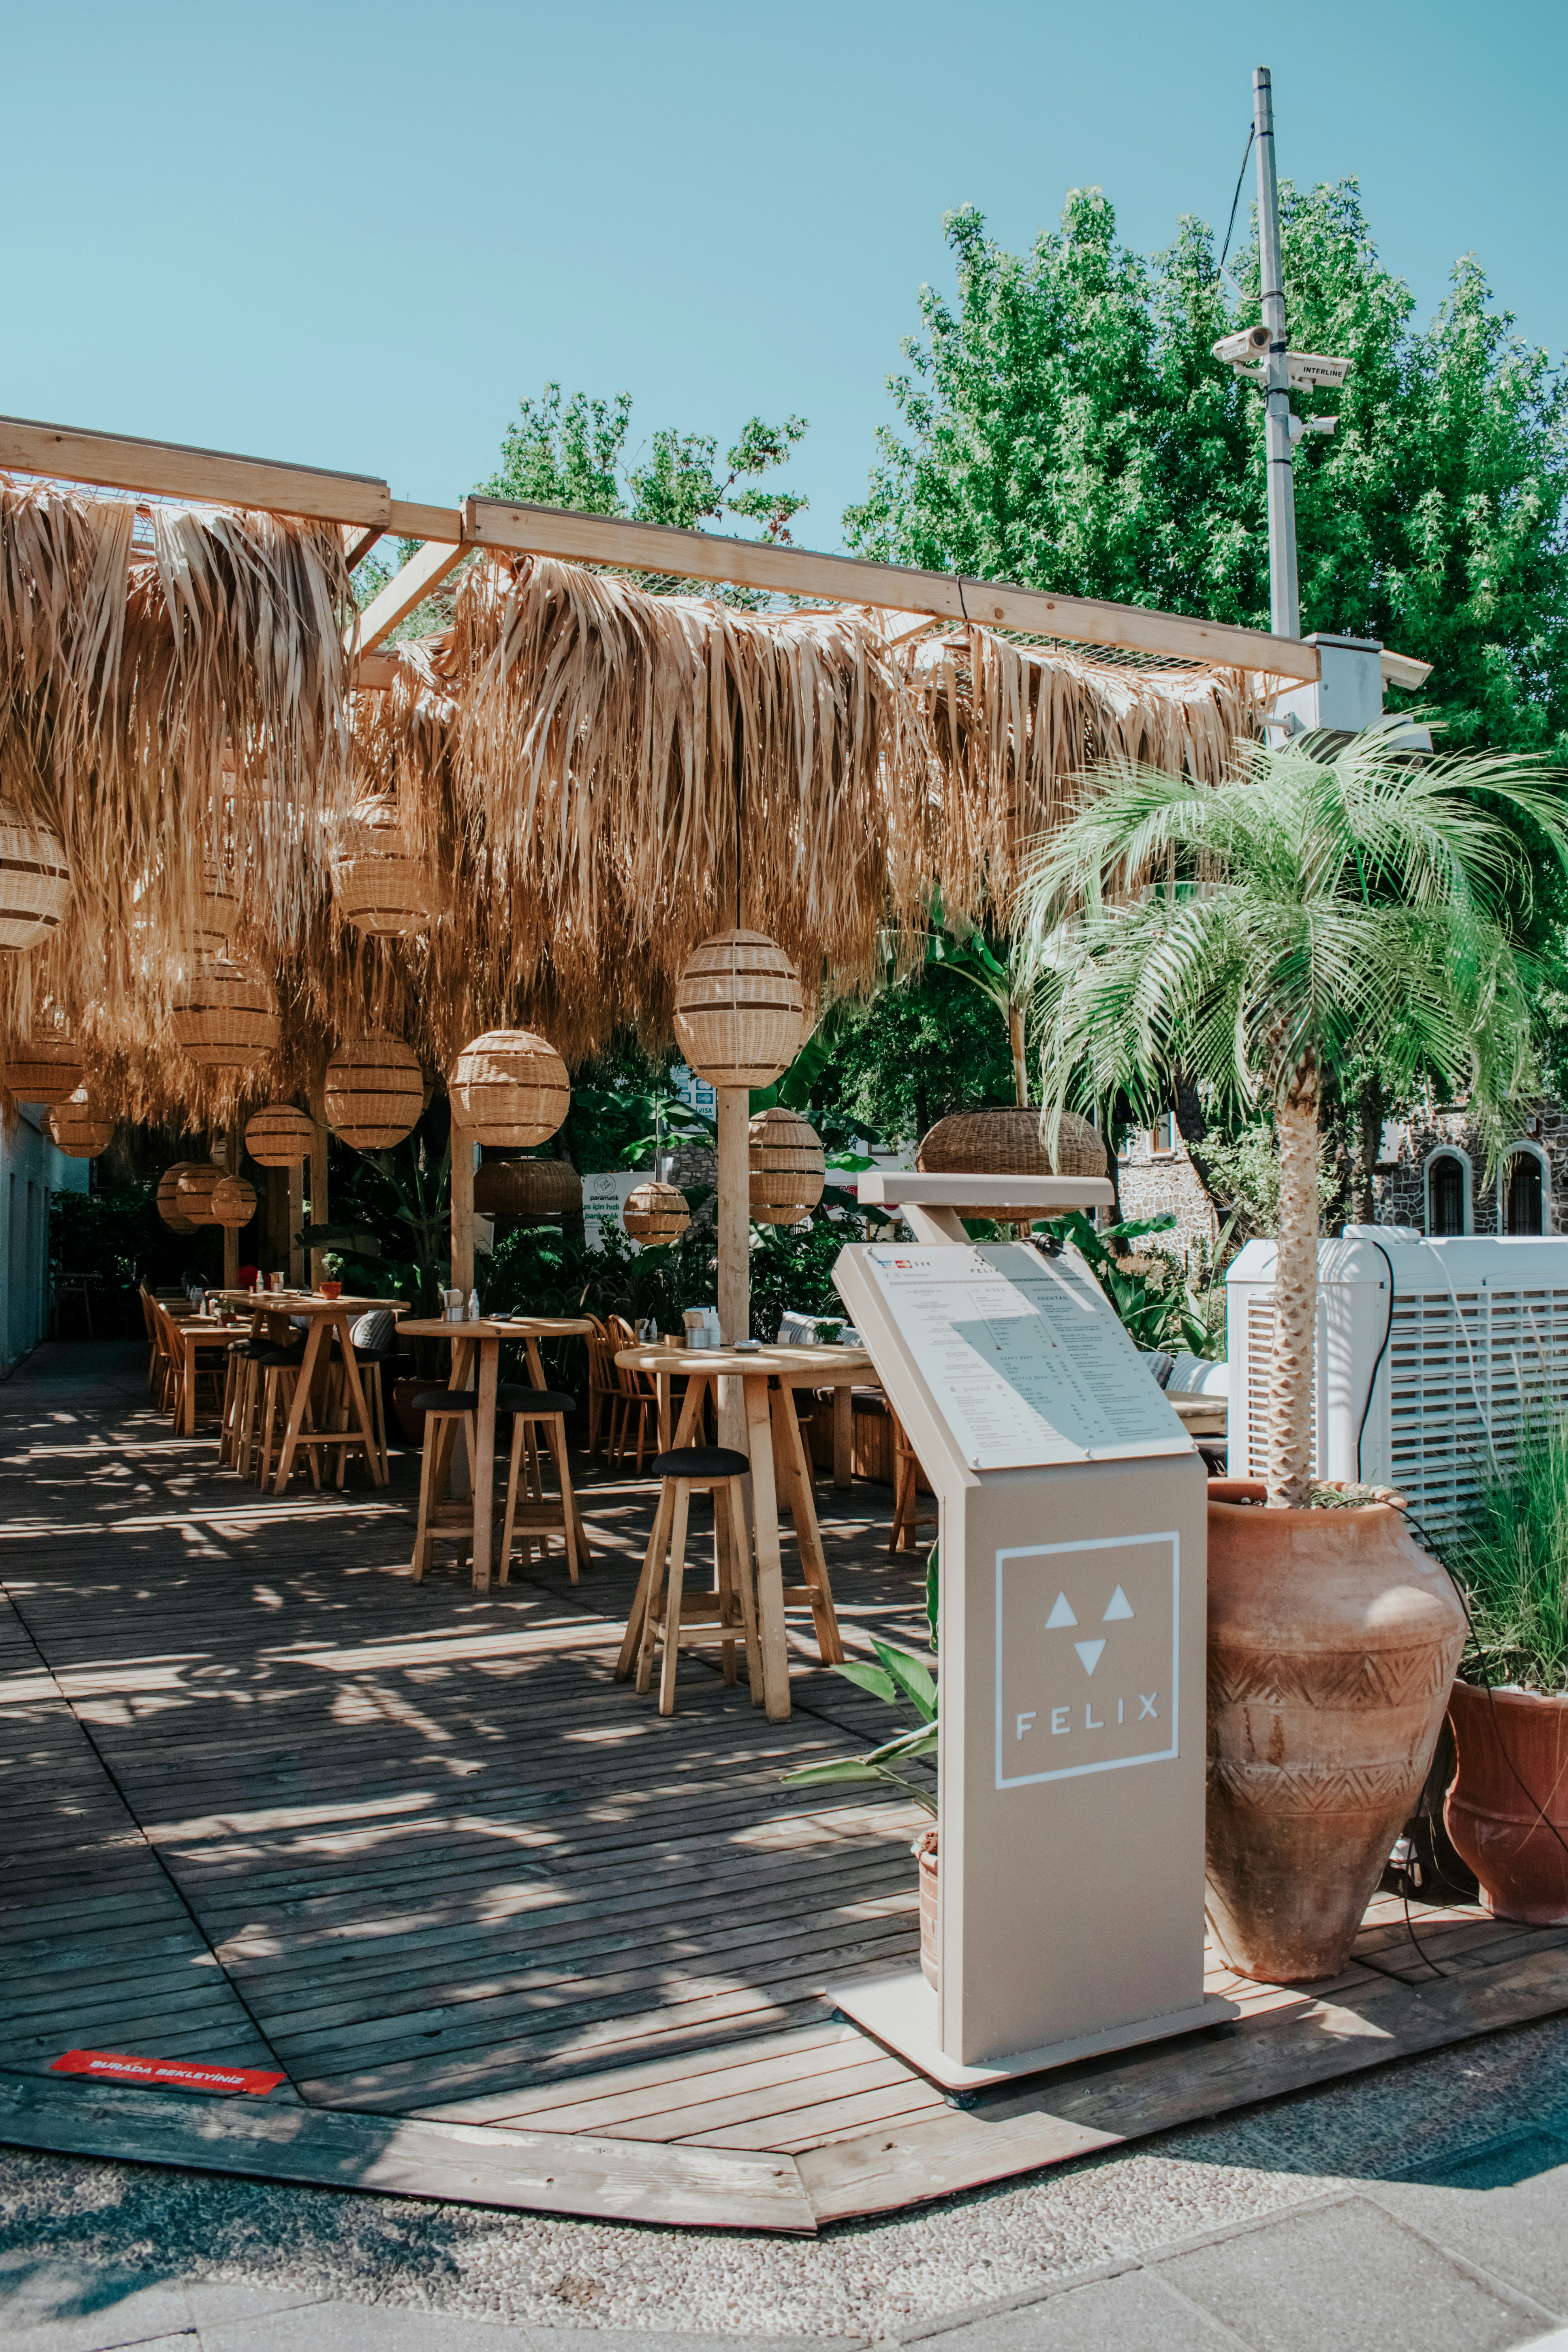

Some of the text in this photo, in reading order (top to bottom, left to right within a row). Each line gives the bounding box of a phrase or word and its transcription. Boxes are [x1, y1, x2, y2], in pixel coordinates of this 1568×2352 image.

[1224, 346, 1247, 357] INTERLINE
[1303, 367, 1342, 377] INTERLINE
[1017, 1692, 1159, 1741] FELIX
[90, 2061, 244, 2084] BURADA BEKLEYİNİZ
